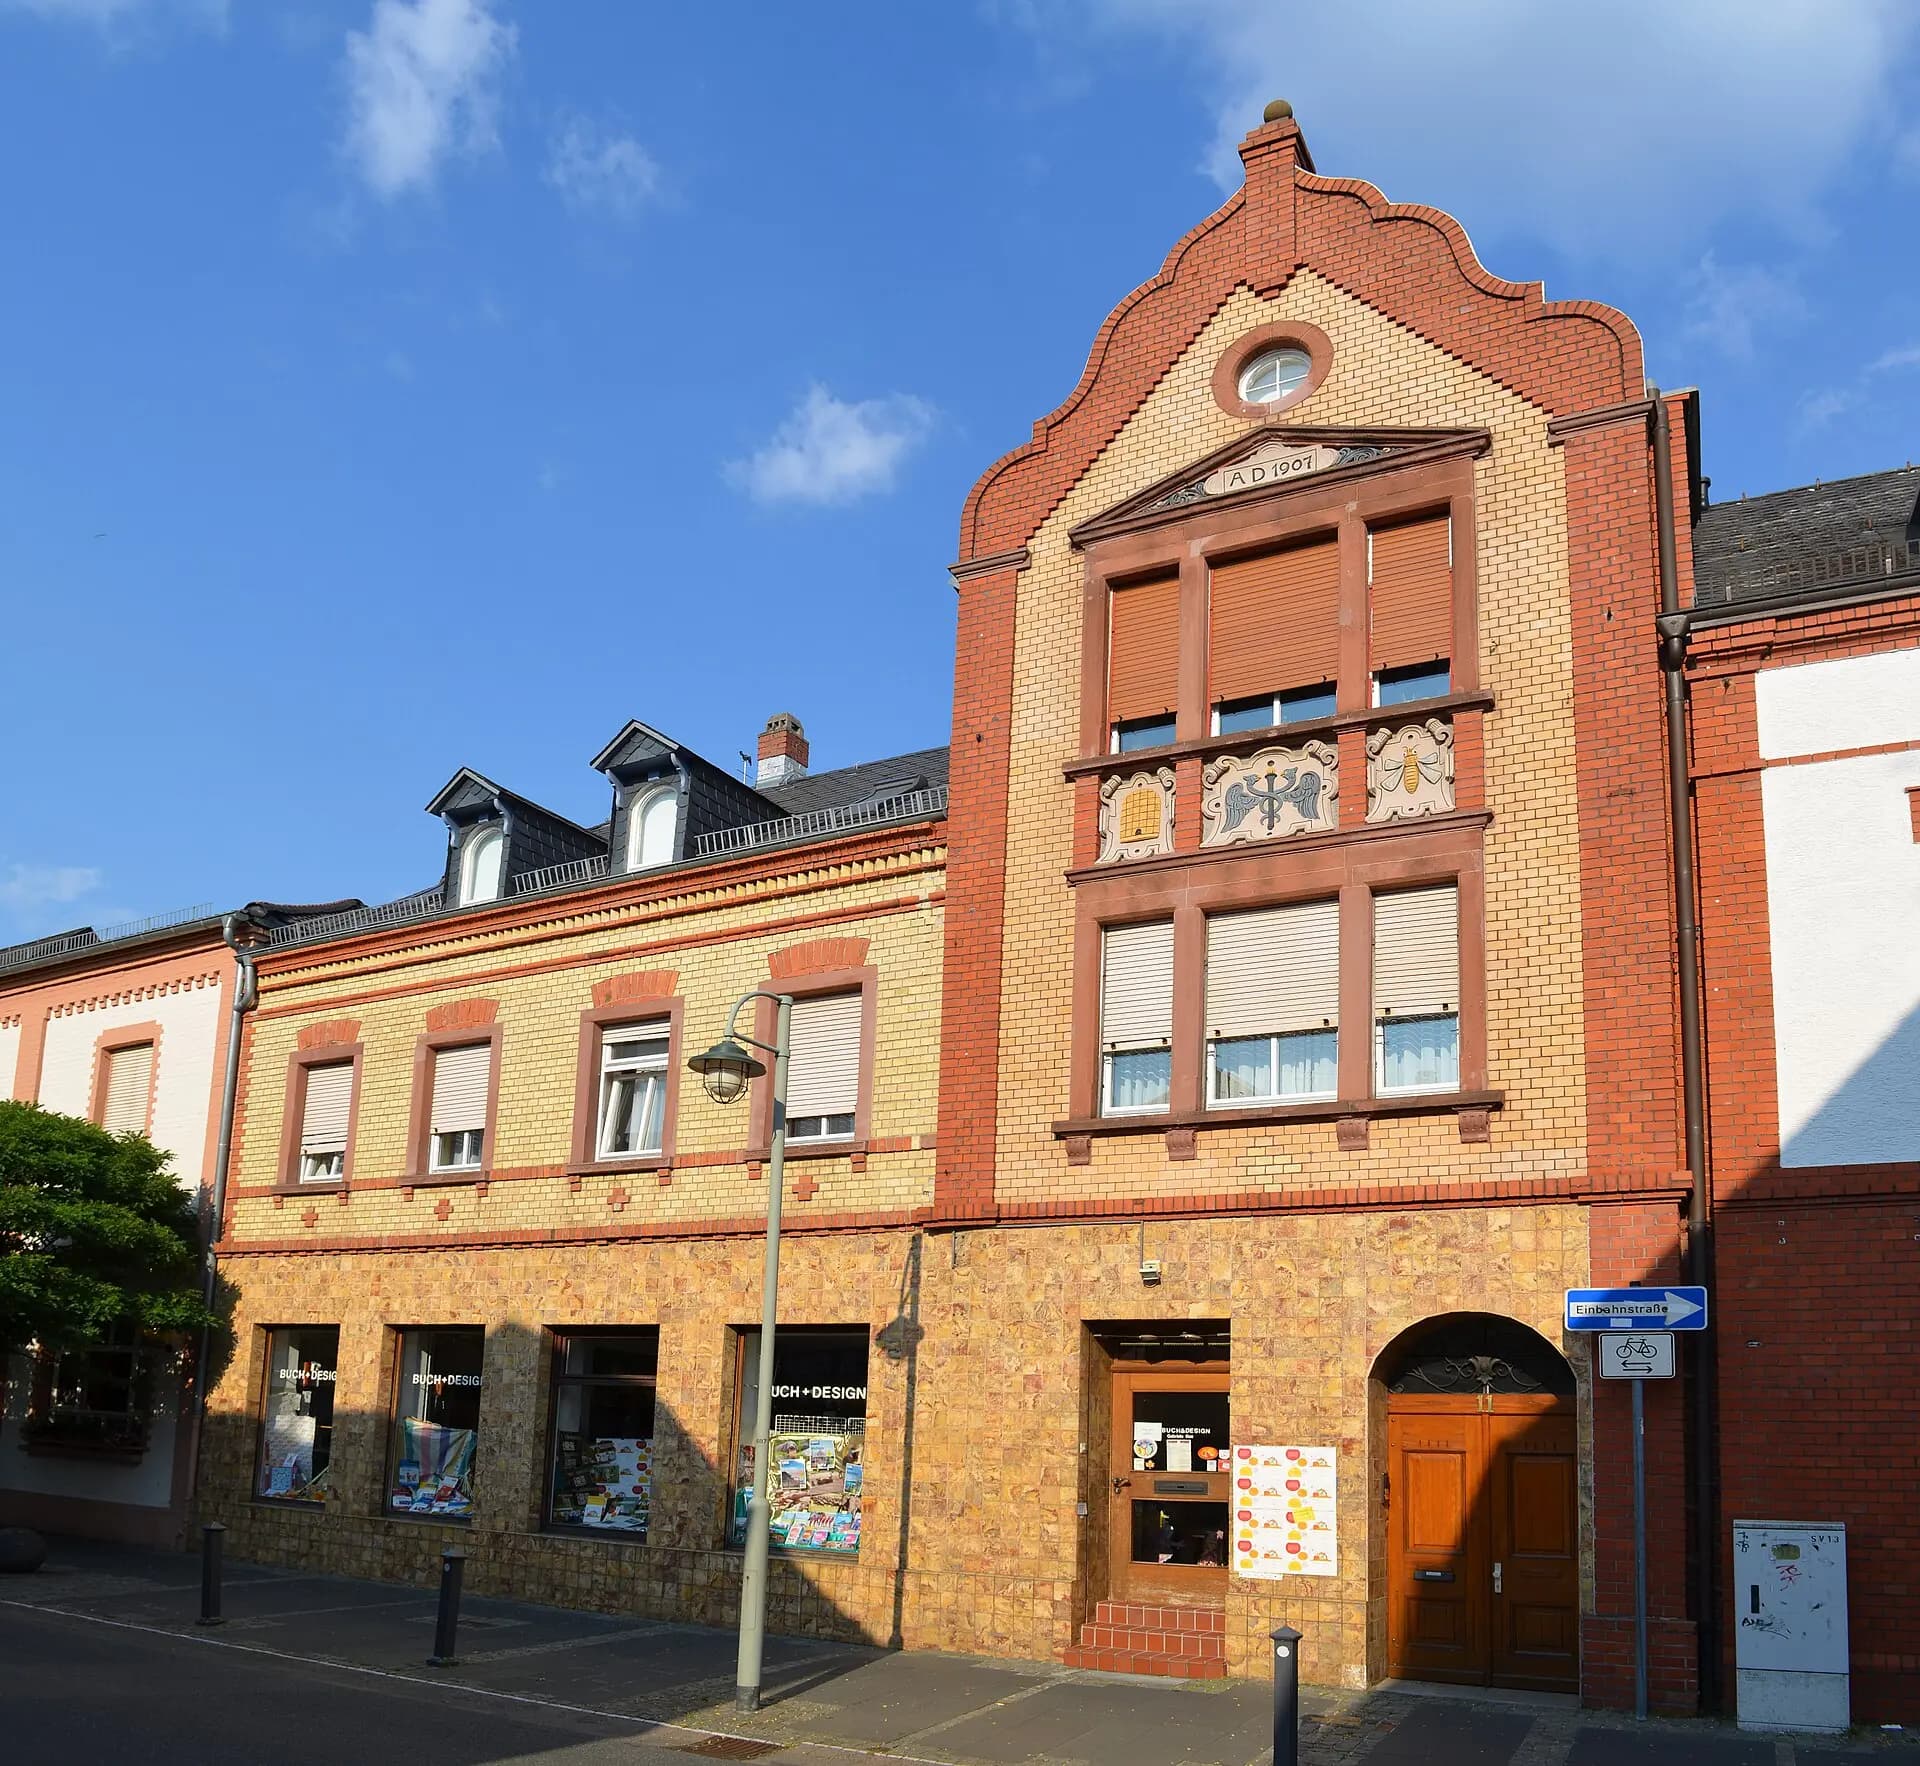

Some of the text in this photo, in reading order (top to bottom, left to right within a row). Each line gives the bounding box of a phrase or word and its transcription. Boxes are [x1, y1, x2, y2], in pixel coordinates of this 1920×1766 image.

[1271, 455, 1313, 478] 1907
[1576, 1303, 1669, 1315] Einbahnstraße
[279, 1368, 337, 1381] BUCH+DESIG
[412, 1373, 483, 1386] BUCH+DESIG
[1476, 1394, 1494, 1413] 11
